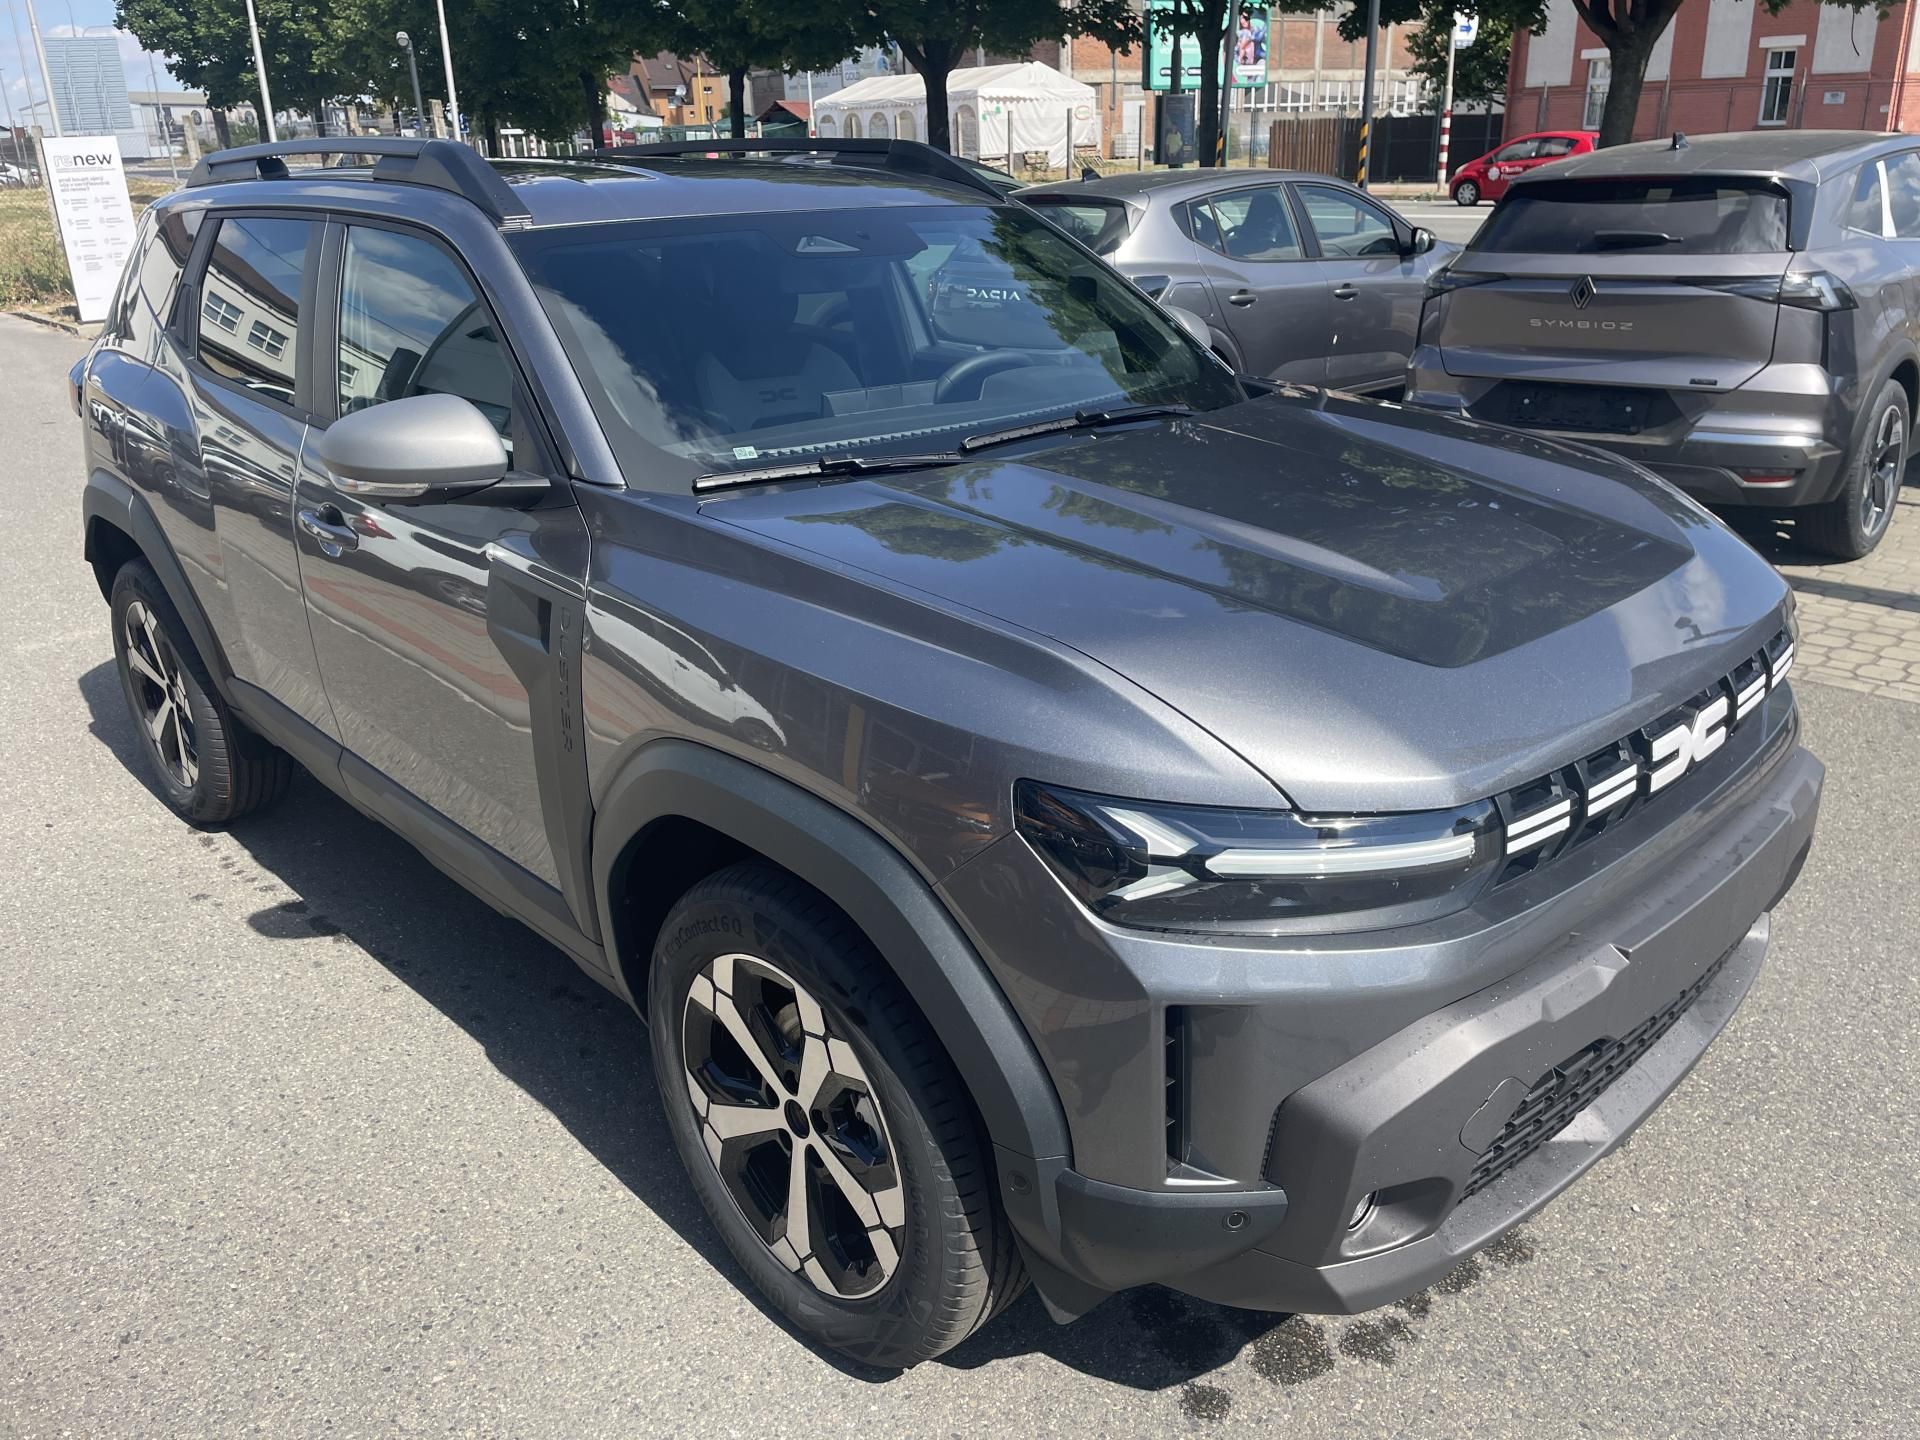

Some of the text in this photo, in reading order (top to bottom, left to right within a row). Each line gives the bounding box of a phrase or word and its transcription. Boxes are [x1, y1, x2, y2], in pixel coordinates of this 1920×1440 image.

[53, 153, 112, 167] renew
[966, 288, 1021, 301] DACIA
[1529, 318, 1633, 331] SYMBIOZ
[559, 606, 573, 752] DUSTER
[721, 915, 730, 933] 6
[732, 918, 745, 938] Q
